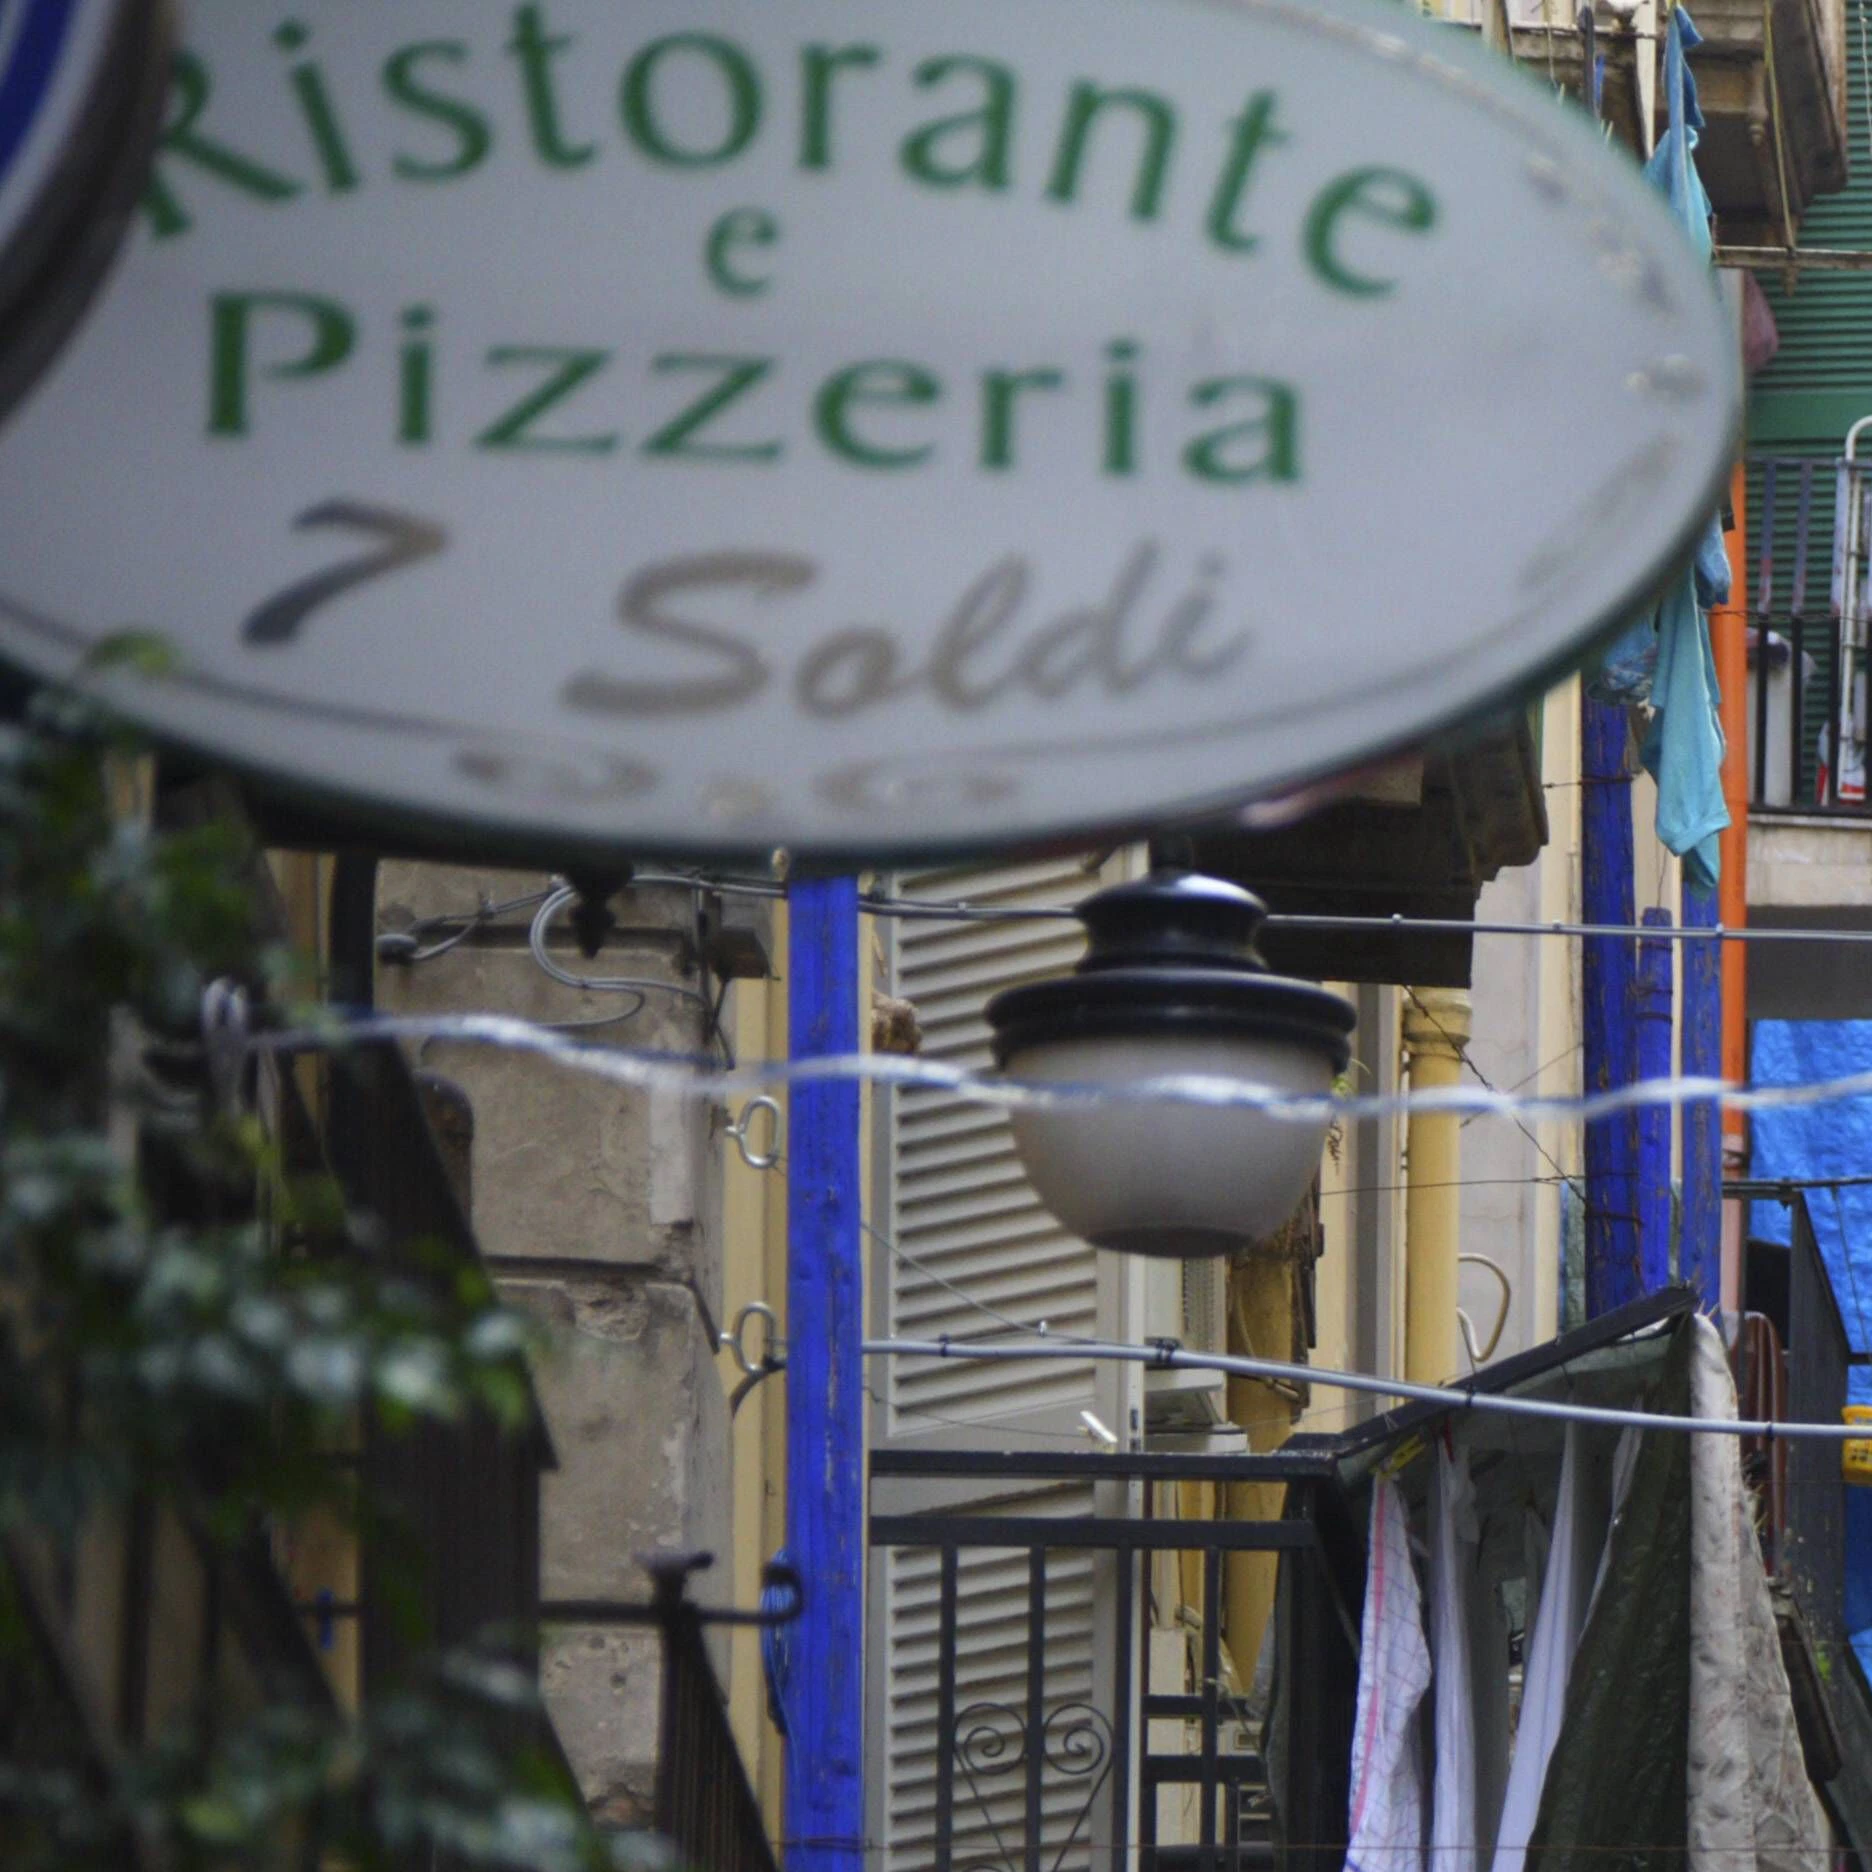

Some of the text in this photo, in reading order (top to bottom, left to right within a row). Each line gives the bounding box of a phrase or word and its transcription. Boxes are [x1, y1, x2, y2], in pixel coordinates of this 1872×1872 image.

[140, 2, 1440, 299] Ristorante
[704, 205, 780, 297] e
[208, 290, 1308, 487] Pizzeria
[243, 500, 1250, 719] 7 Soldi
